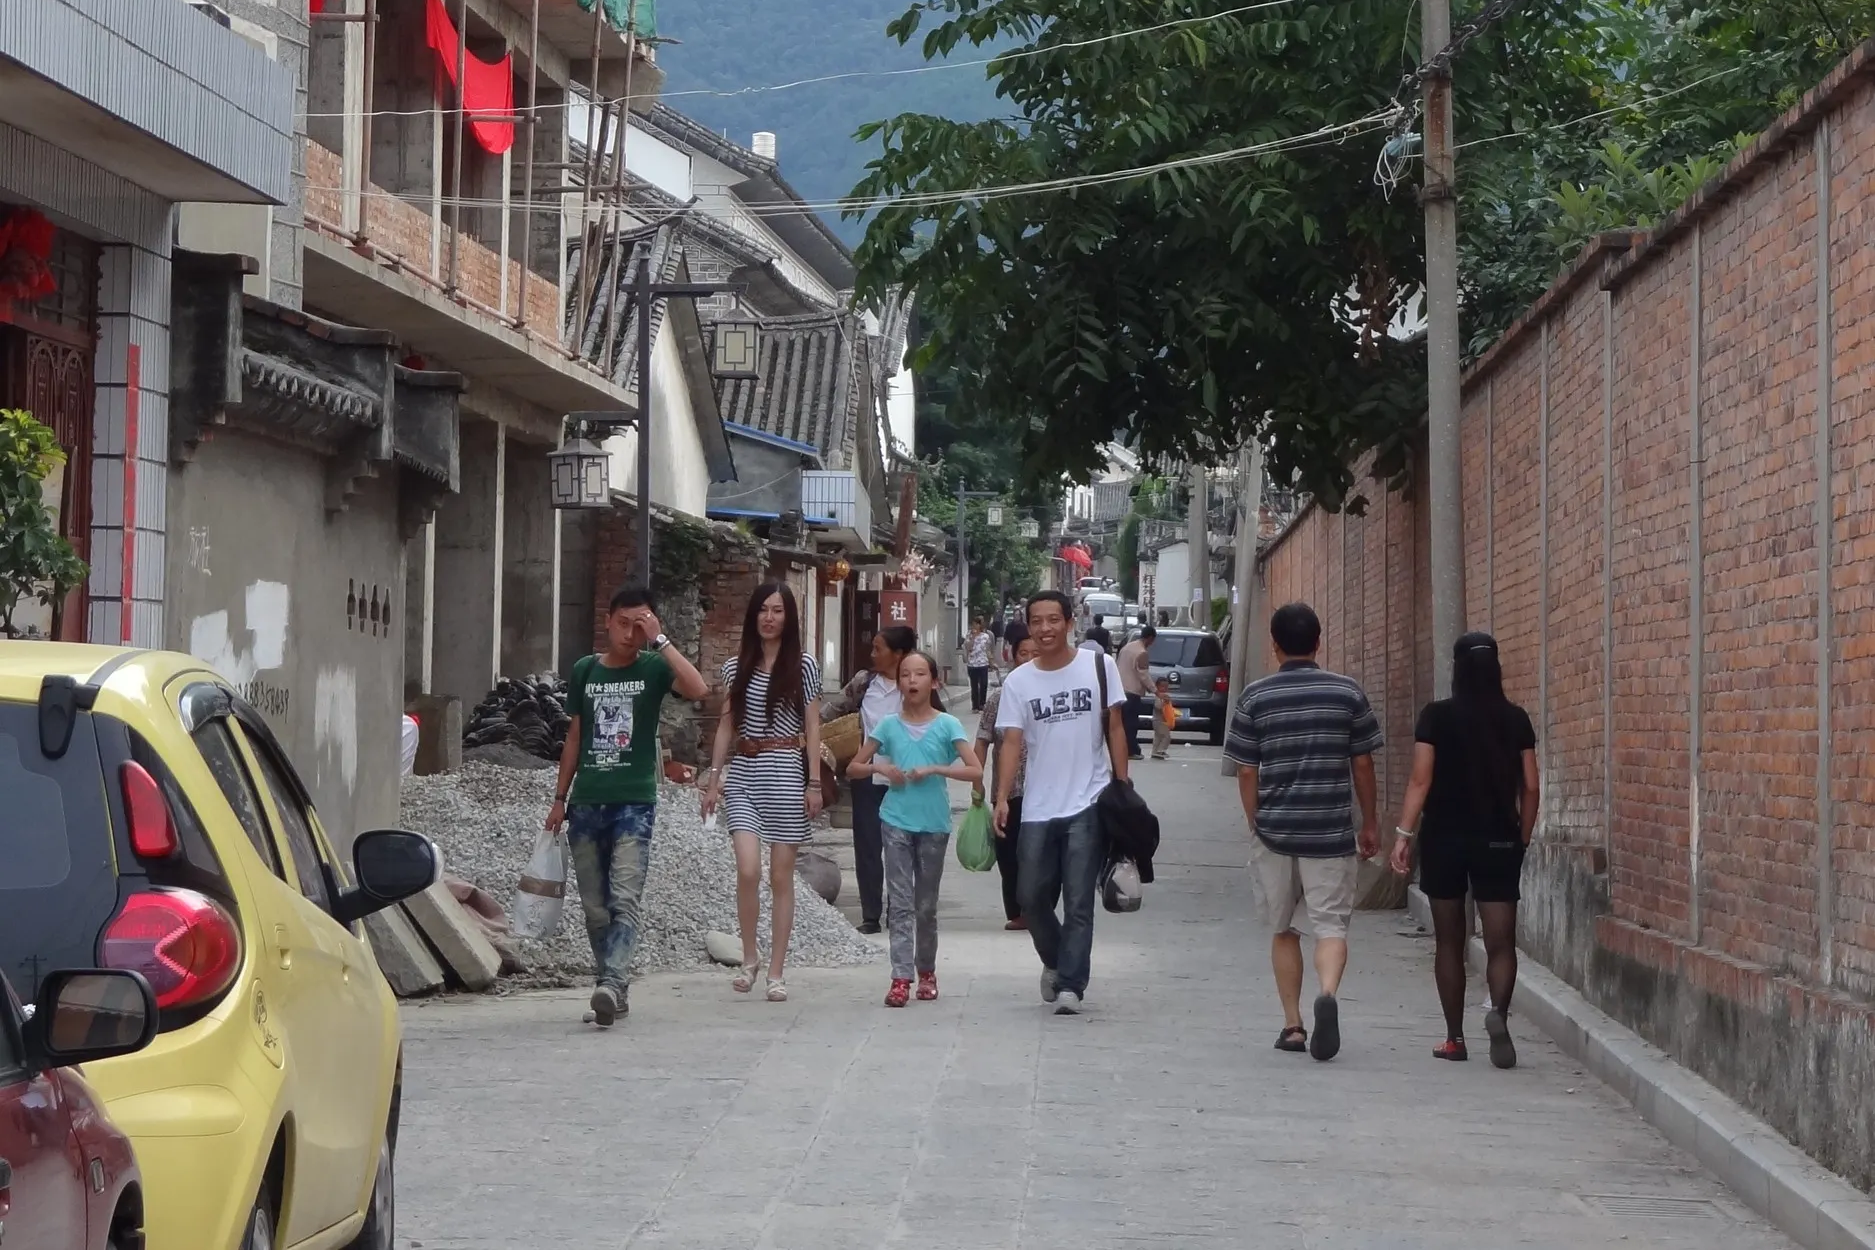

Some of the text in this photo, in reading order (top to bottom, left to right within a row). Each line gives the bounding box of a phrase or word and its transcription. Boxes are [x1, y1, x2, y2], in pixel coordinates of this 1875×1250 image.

[890, 601, 907, 621] 社
[603, 680, 646, 693] SNEAKERS
[1028, 687, 1092, 721] LEE
